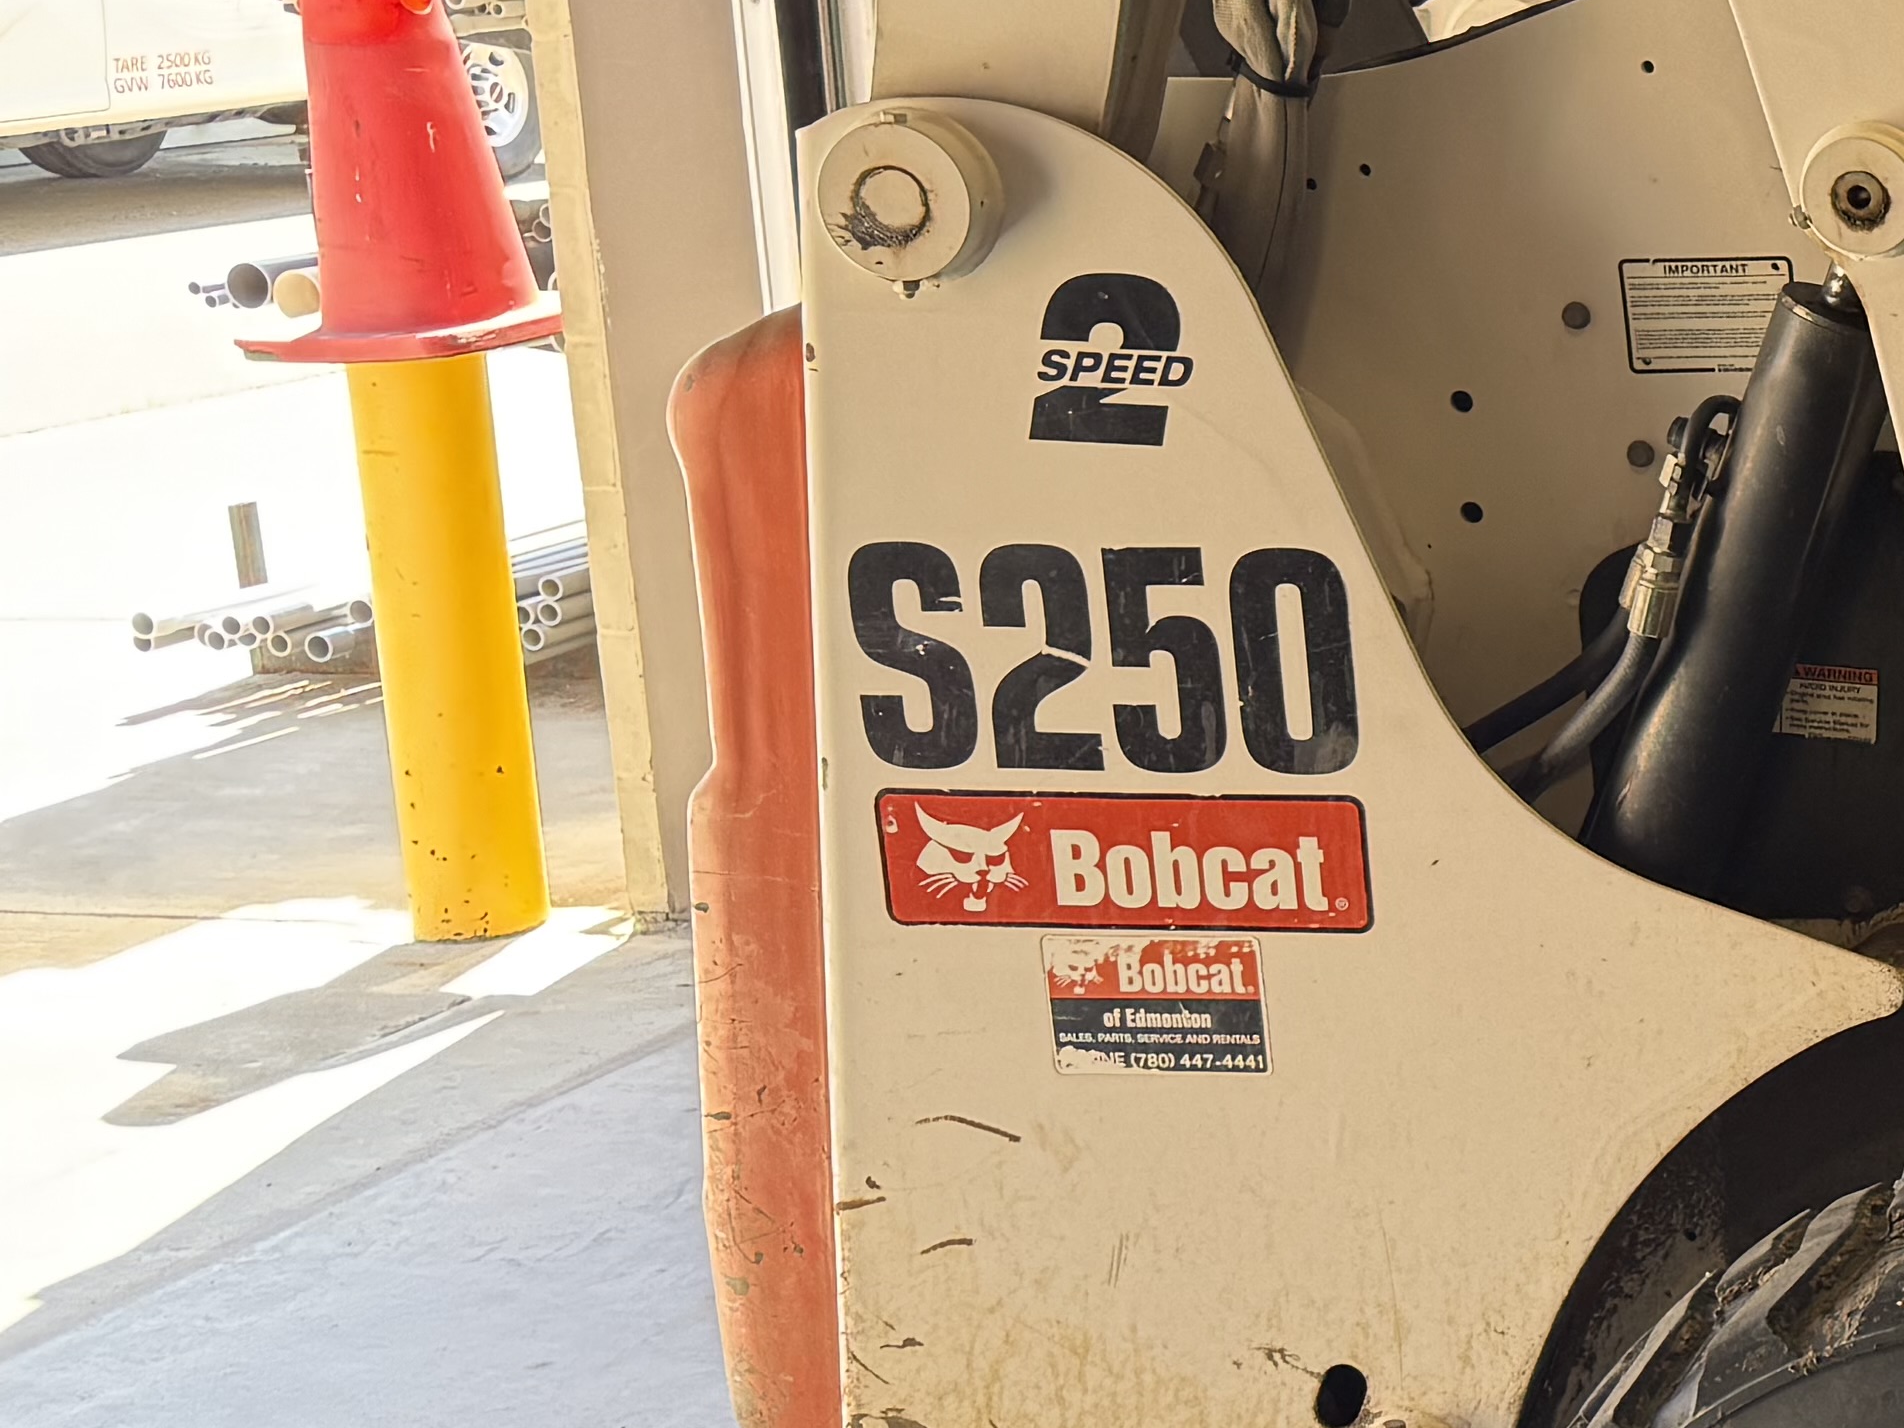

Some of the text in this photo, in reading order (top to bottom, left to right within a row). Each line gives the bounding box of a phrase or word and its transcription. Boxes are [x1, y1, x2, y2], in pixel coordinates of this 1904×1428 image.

[113, 50, 211, 73] TARE 2500 KG
[114, 69, 213, 93] GVW 7600 KG
[1663, 264, 1748, 276] IMPORTANT
[1028, 271, 1181, 447] 2
[1035, 347, 1194, 389] SPEED
[845, 540, 1361, 776] S250
[1803, 667, 1873, 682] WARNING
[1052, 829, 1329, 914] Bobcat
[1117, 949, 1247, 993] Bobcat
[1103, 1009, 1212, 1029] of Edmonton
[1059, 1032, 1260, 1045] SALES, PARTS, SERVICE AND RENTALS
[1130, 1052, 1175, 1068] (780)
[1180, 1053, 1264, 1069] 447-4441
